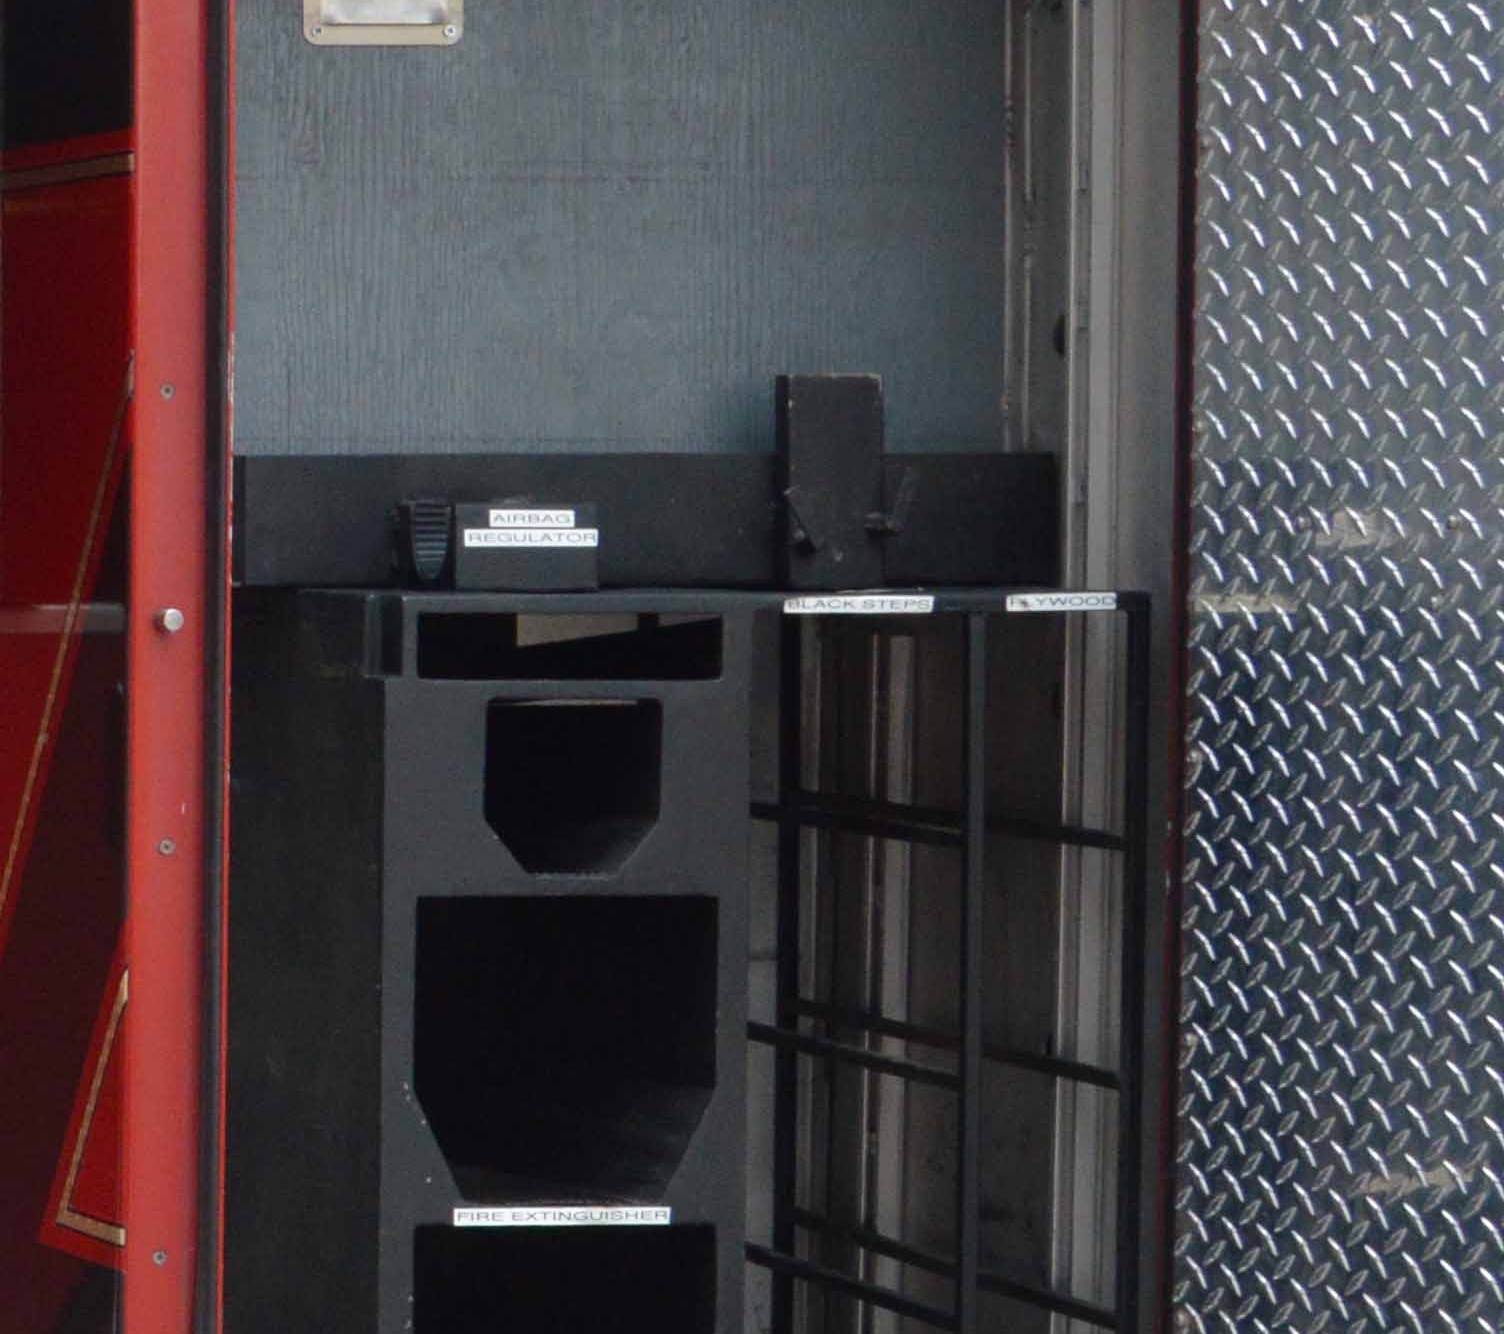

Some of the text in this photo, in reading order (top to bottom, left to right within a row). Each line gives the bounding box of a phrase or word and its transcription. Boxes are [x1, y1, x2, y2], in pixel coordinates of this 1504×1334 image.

[493, 513, 571, 524] AIRBAG
[468, 532, 596, 543] REGULATOR
[788, 598, 931, 610] BLACK STEPS
[457, 1210, 669, 1222] FIRE EXTINGUISHER
